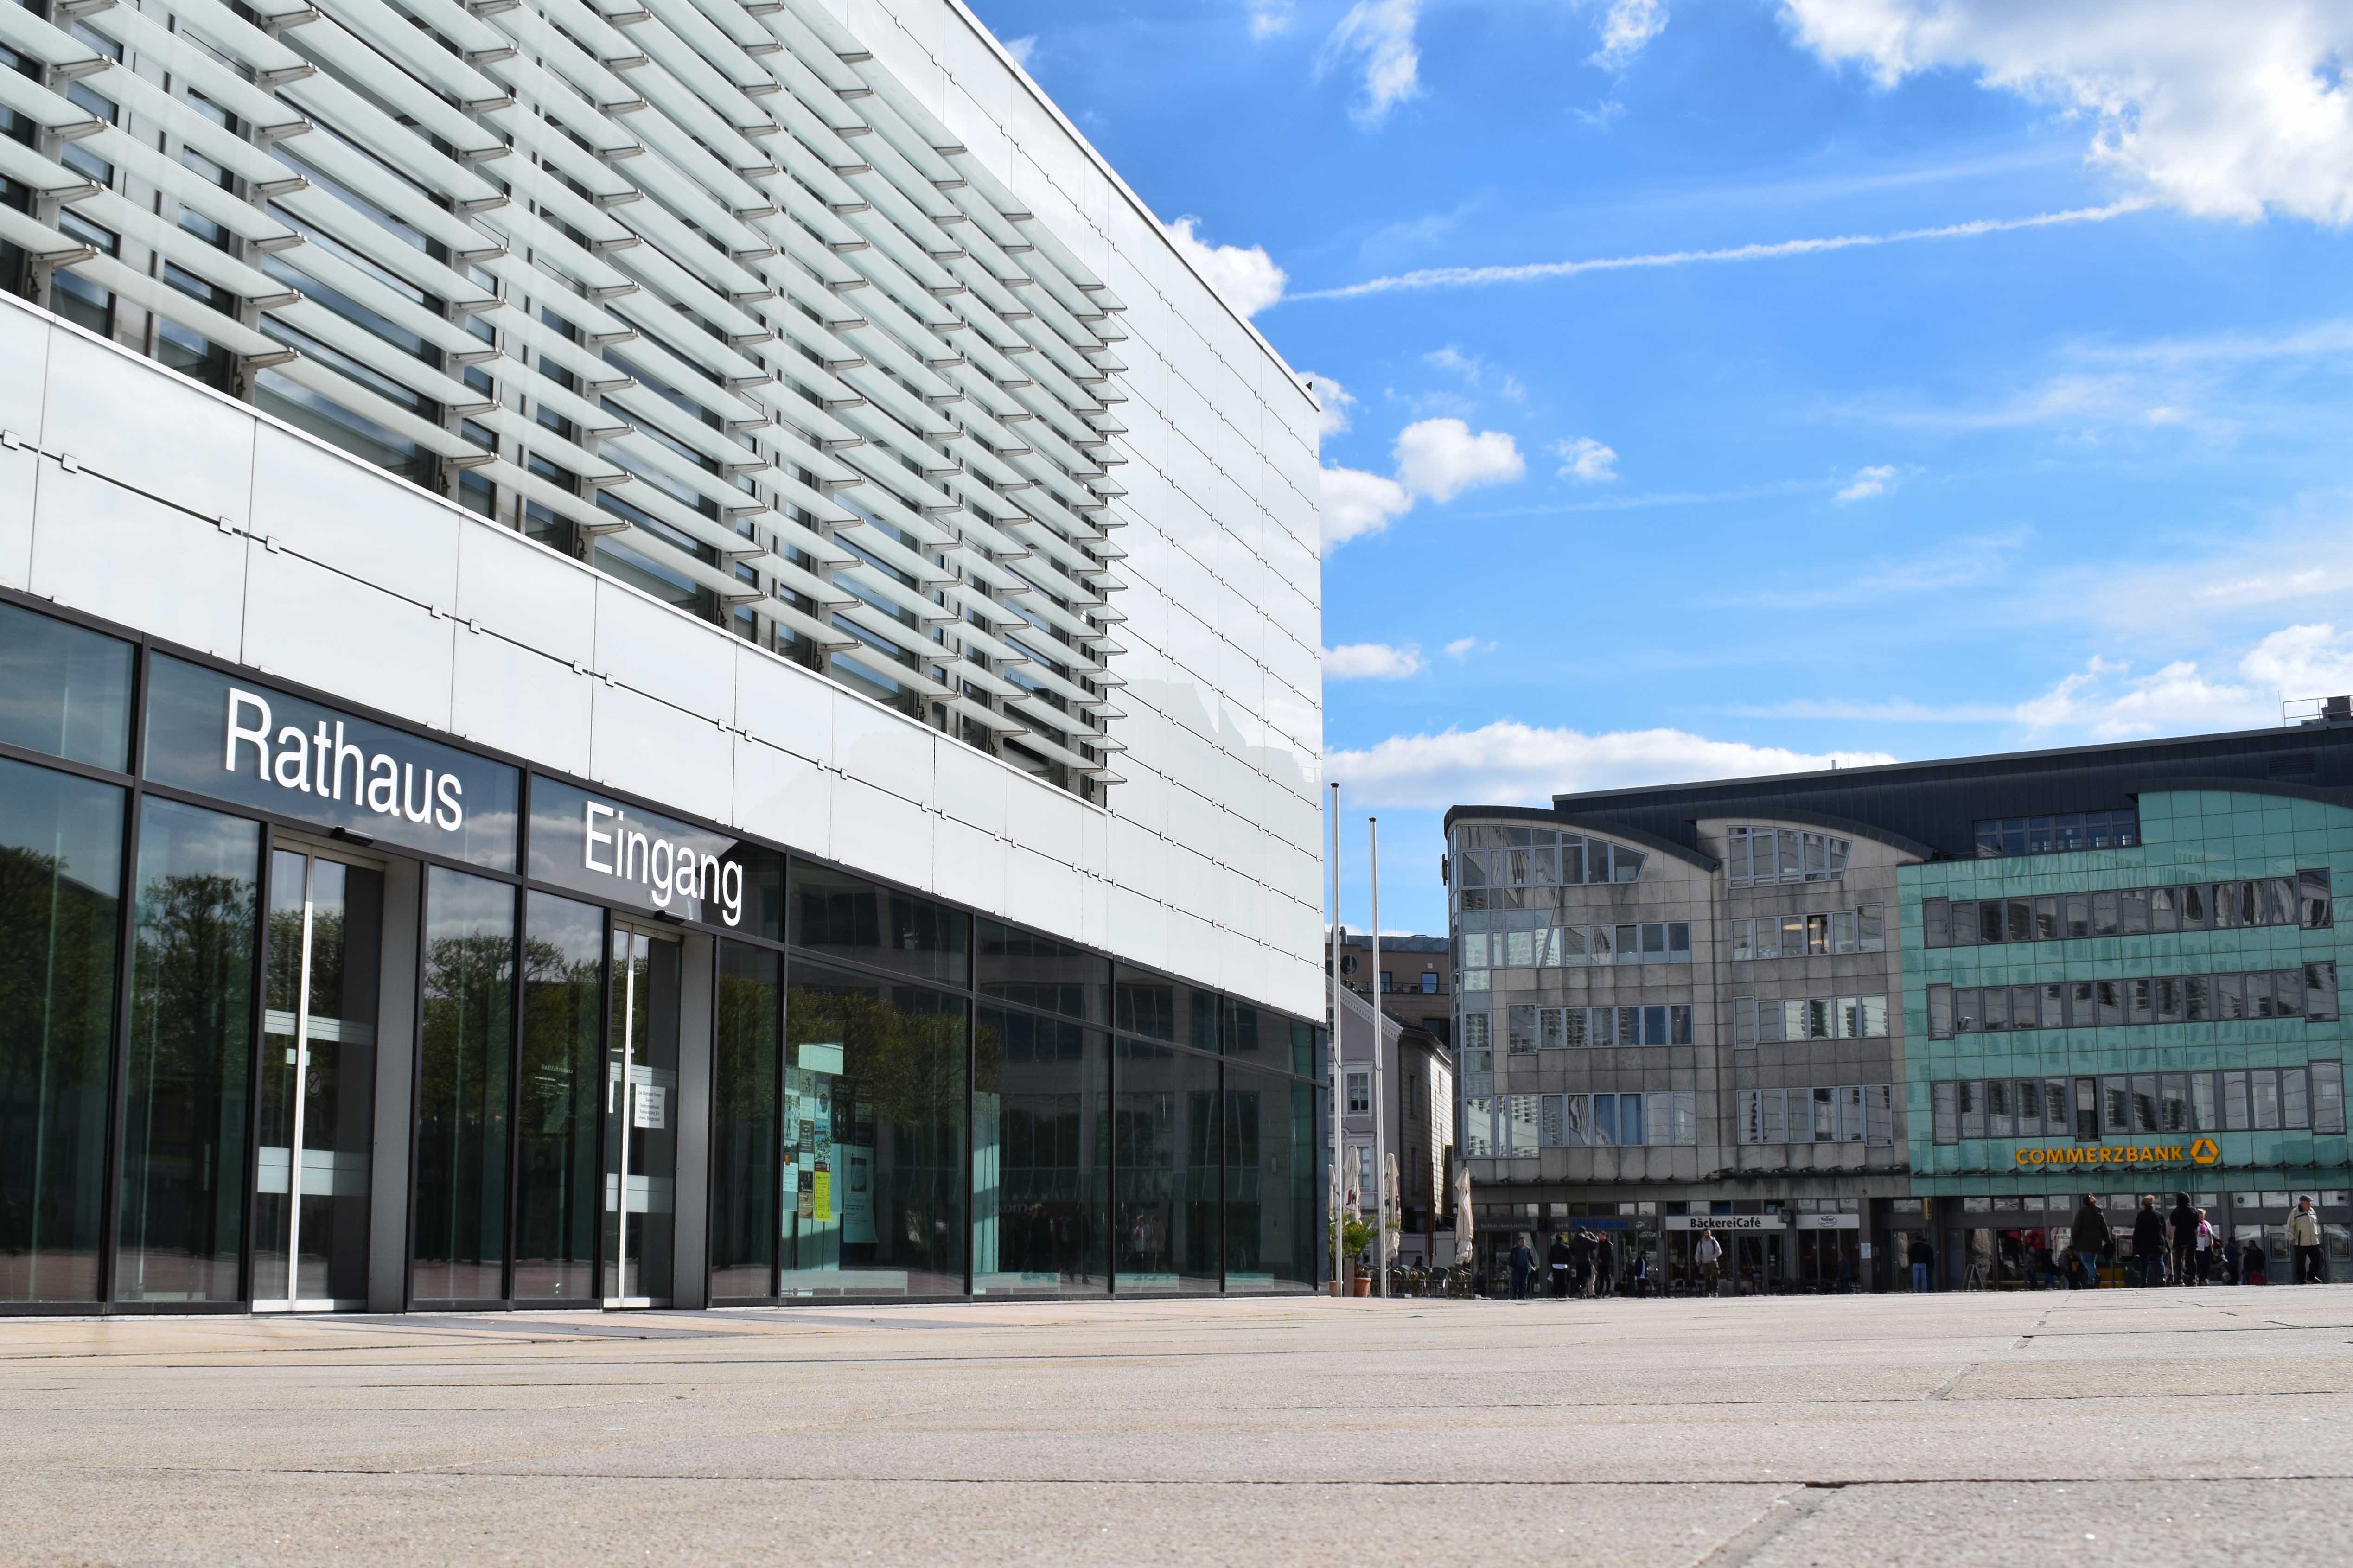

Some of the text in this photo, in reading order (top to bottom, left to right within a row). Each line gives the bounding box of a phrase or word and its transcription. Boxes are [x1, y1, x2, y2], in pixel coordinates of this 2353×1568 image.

[226, 687, 463, 831] Rathaus
[585, 800, 743, 926] Eingang
[2016, 1145, 2184, 1165] COMMERZBANK
[1690, 1217, 1761, 1228] BäckereiCafé
